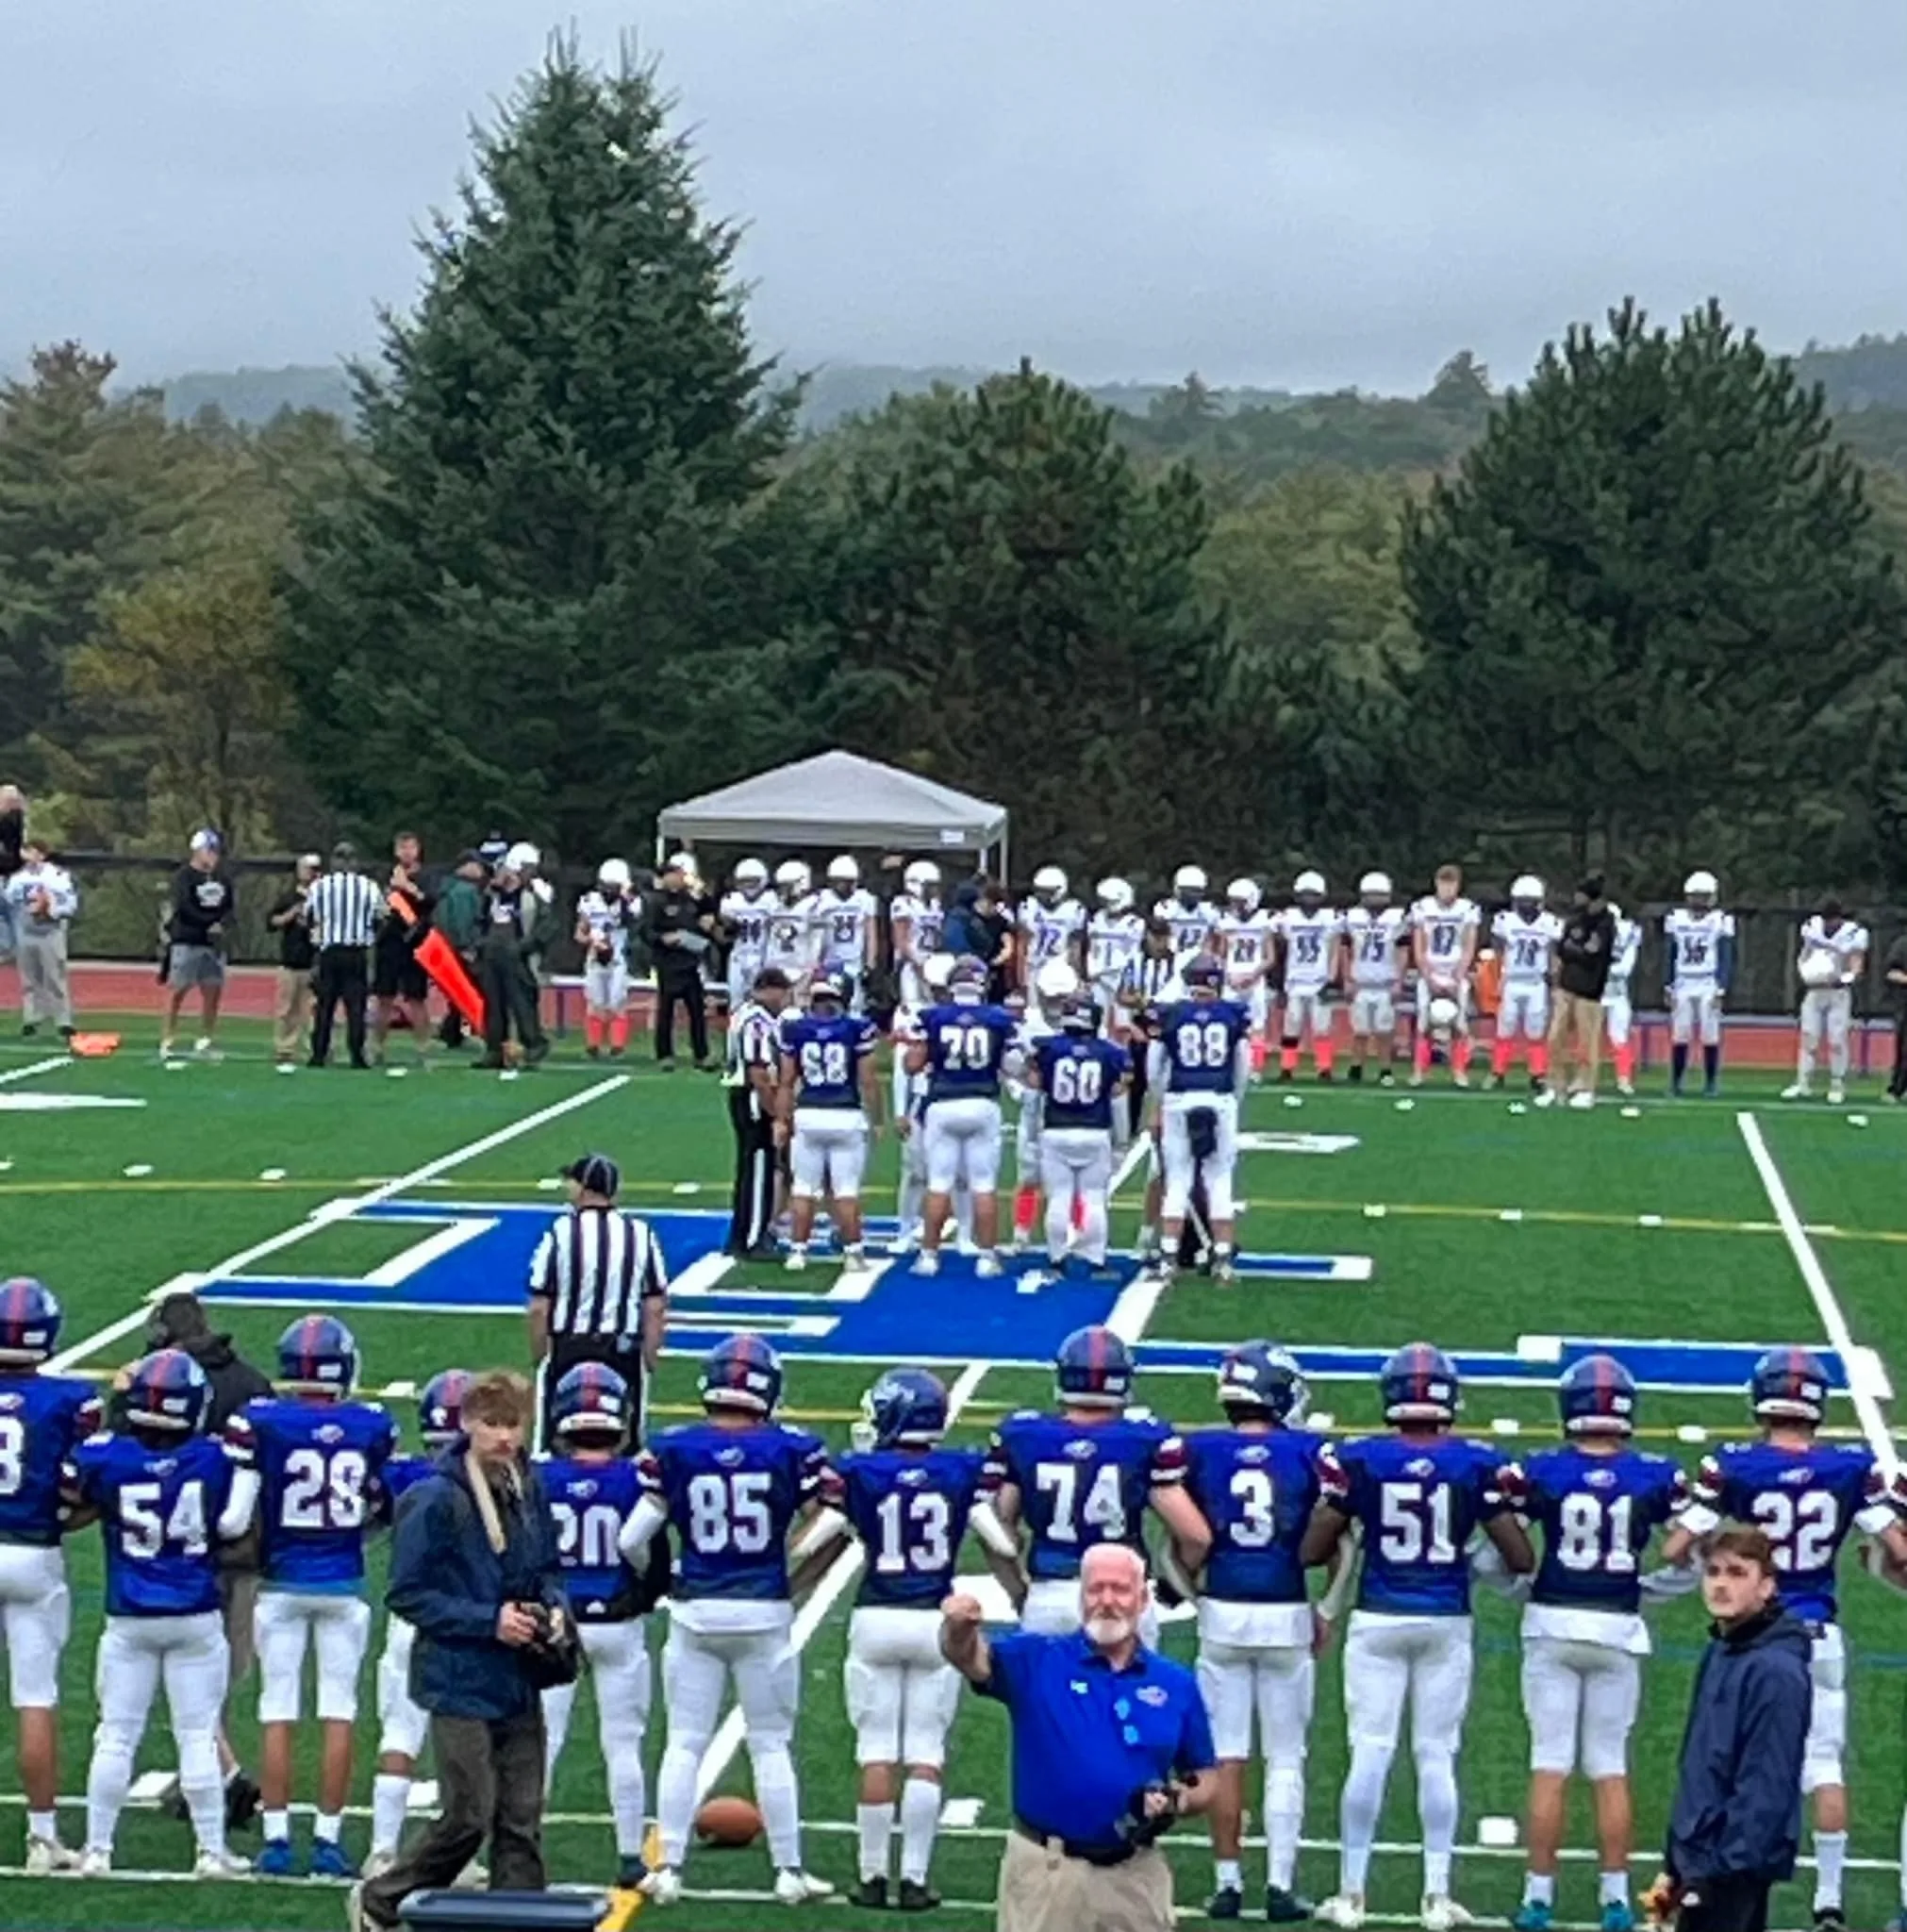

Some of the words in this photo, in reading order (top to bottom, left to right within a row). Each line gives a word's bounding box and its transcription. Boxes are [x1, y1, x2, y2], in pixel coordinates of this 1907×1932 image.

[801, 1042, 847, 1086] 68
[940, 1026, 988, 1068] 70
[1053, 1058, 1101, 1103] 60
[1178, 1024, 1227, 1066] 88
[121, 1481, 207, 1557] 54
[282, 1450, 365, 1526] 28
[689, 1474, 770, 1551] 85
[1037, 1463, 1124, 1540] 74
[1231, 1470, 1272, 1545] 3
[1382, 1483, 1454, 1562] 51
[877, 1493, 949, 1571] 13
[1558, 1493, 1633, 1571] 81
[1752, 1491, 1837, 1570] 22
